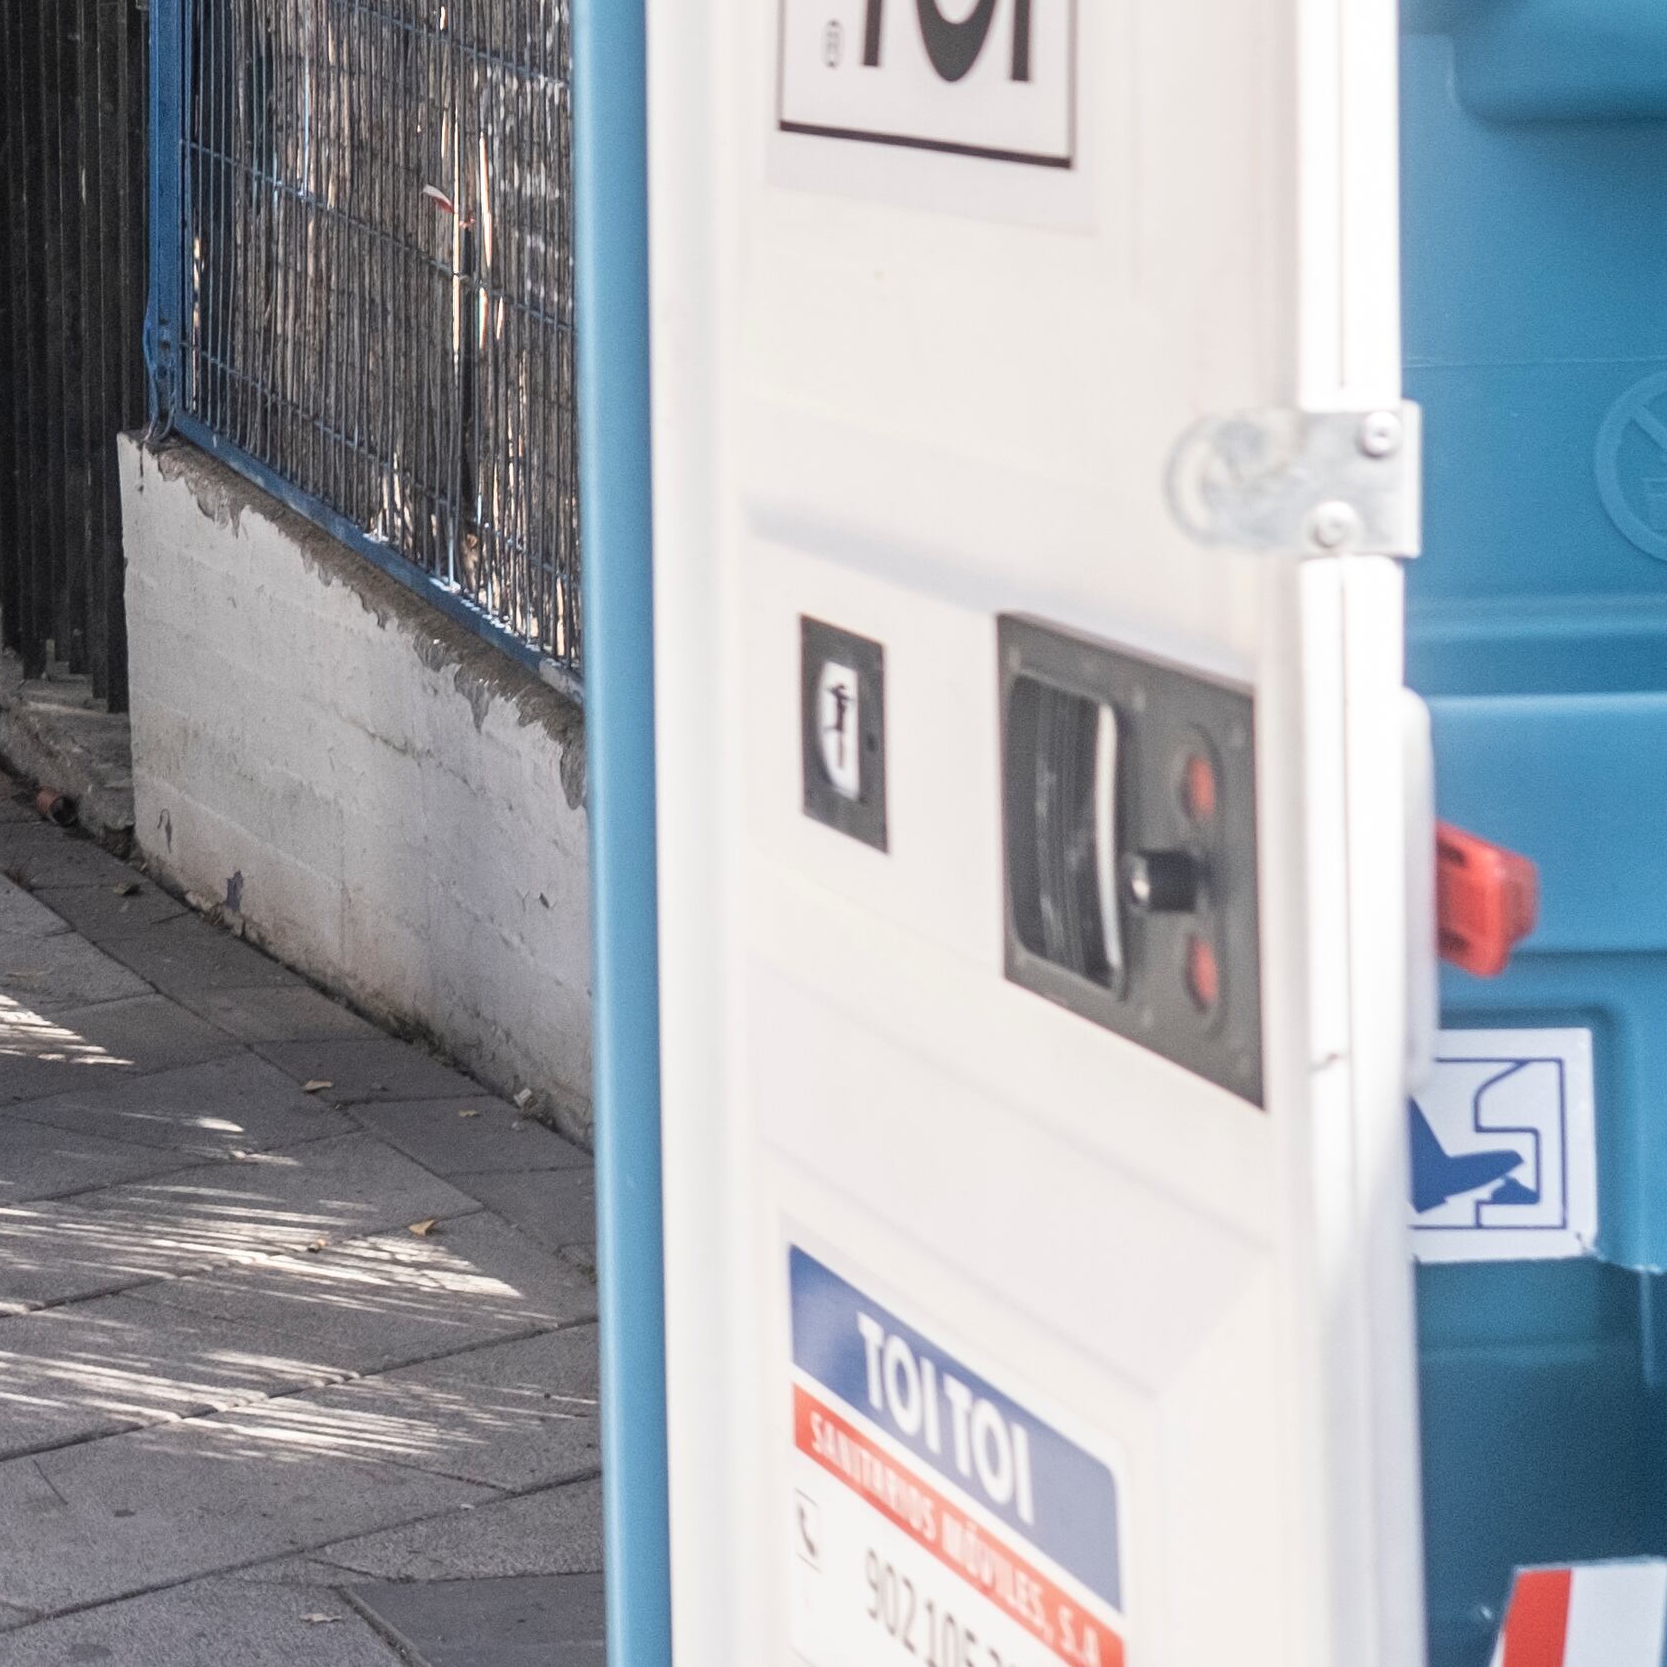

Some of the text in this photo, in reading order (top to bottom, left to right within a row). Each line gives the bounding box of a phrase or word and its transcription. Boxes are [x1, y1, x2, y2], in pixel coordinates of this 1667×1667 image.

[810, 1409, 939, 1544] SANITARIOS
[856, 1308, 1035, 1526] TOI TOI
